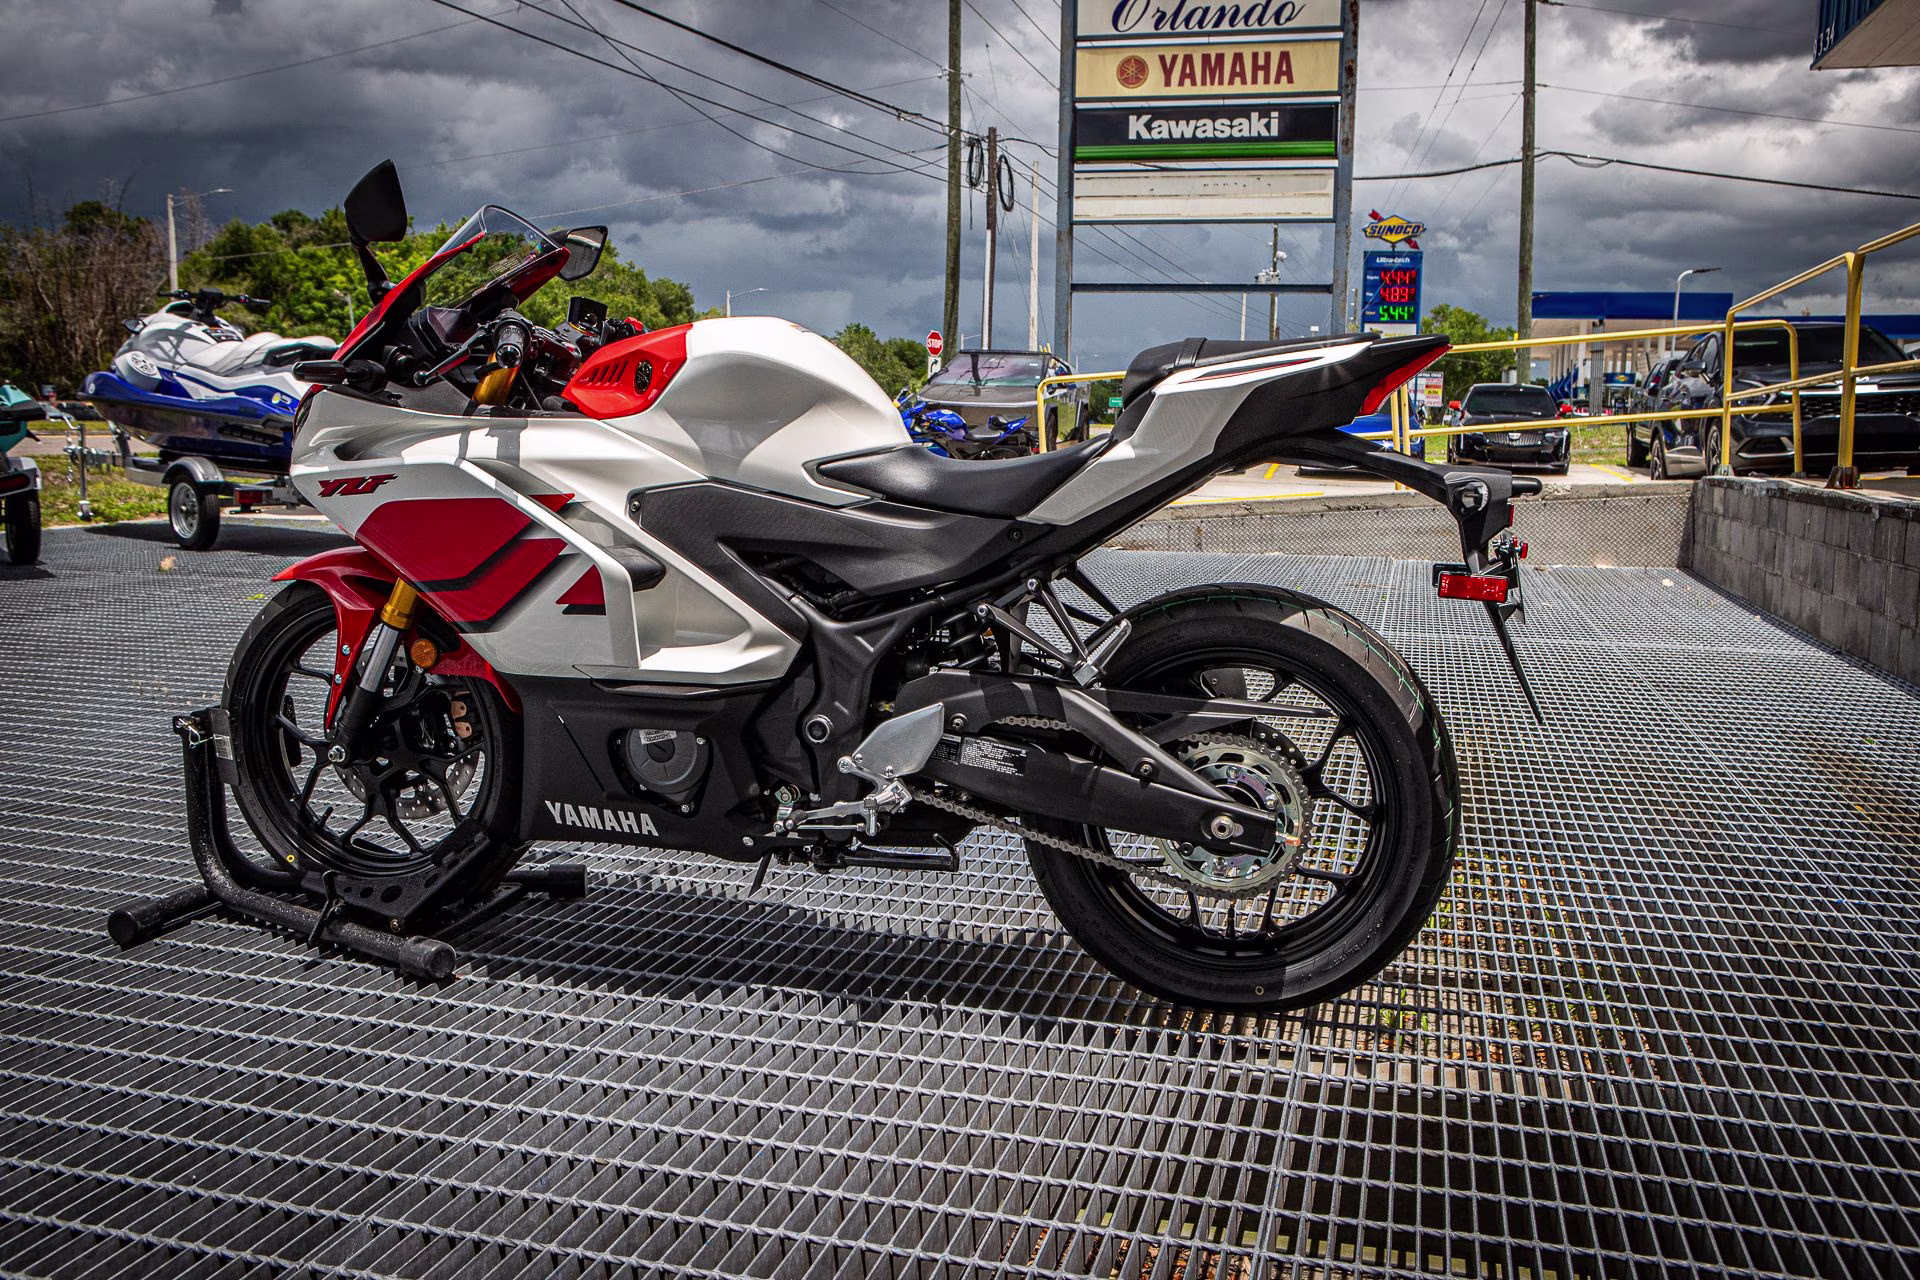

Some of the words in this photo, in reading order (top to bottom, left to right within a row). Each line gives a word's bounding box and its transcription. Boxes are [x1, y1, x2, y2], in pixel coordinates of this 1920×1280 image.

[1112, 0, 1307, 32] Orlando
[1158, 50, 1295, 87] YAMAHA
[1128, 111, 1279, 140] Kawasaki
[1368, 224, 1421, 235] SUNOCO
[928, 338, 942, 348] STOP
[544, 800, 659, 837] YAMAHA
